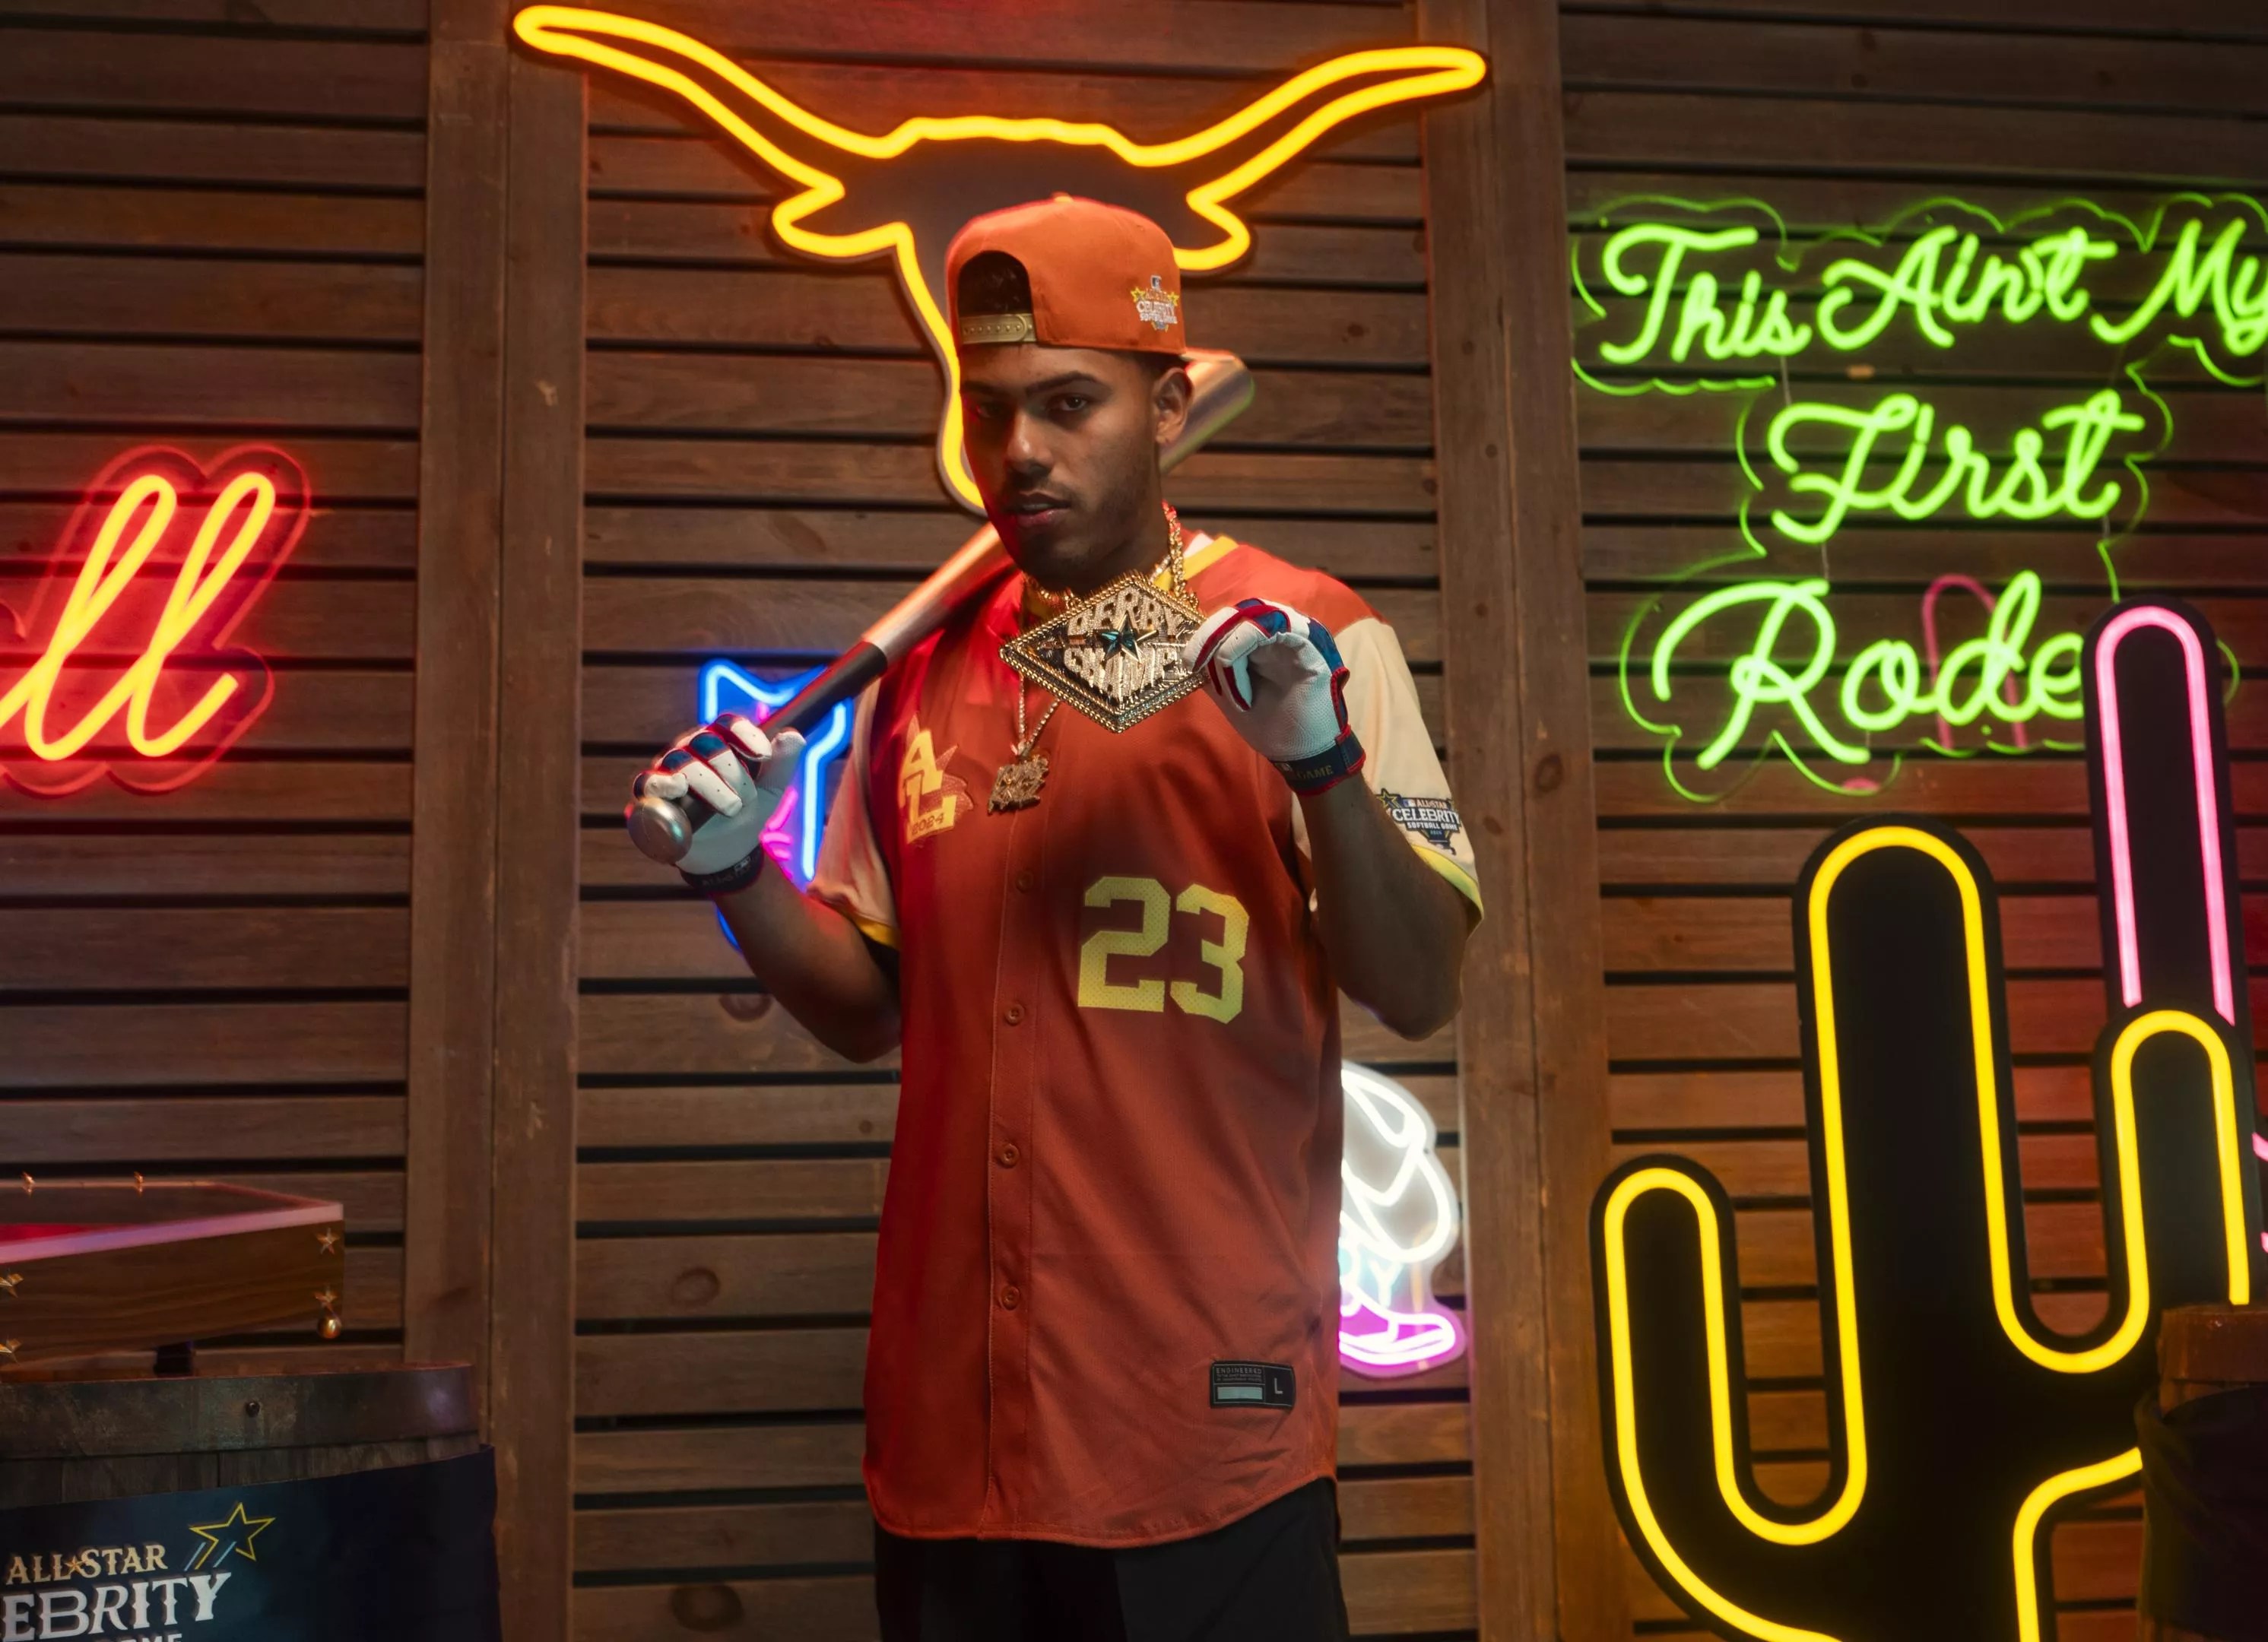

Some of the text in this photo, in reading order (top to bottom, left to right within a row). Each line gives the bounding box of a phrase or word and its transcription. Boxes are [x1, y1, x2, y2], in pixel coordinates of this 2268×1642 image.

[1600, 223, 1813, 365] This
[2090, 218, 2268, 356] My
[1767, 389, 2146, 544] First
[897, 729, 958, 845] AL
[912, 813, 944, 835] 2024
[1392, 808, 1460, 824] CELEBRITY
[1077, 876, 1250, 1024] 23
[1274, 1377, 1283, 1394] L
